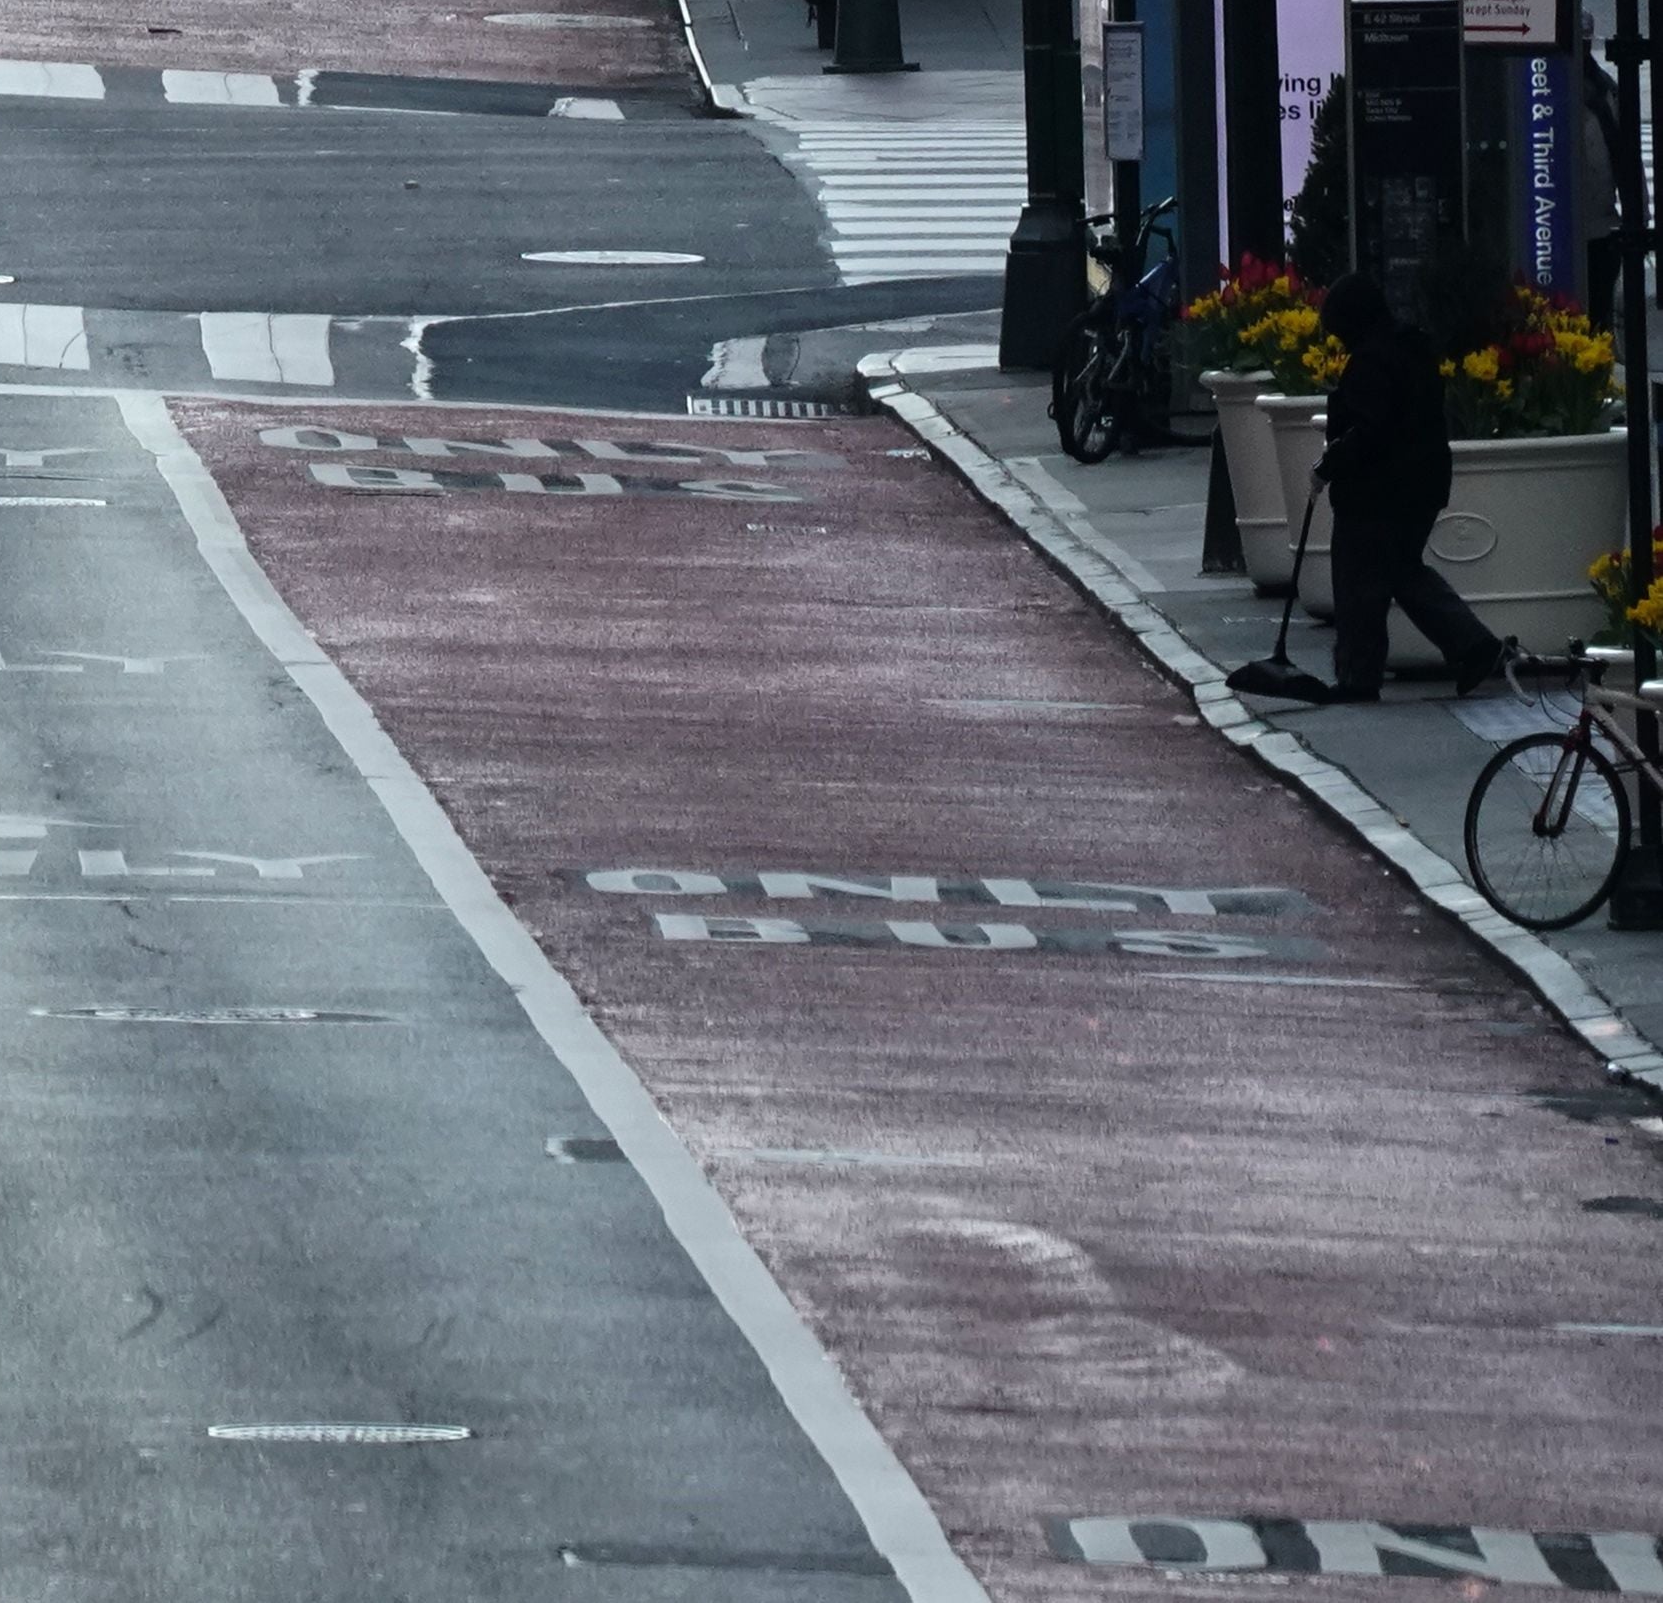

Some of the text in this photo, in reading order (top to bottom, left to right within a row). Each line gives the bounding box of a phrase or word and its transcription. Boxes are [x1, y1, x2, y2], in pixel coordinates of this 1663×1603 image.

[1464, 3, 1530, 17] xcept Sunday
[1532, 103, 1554, 121] &
[1533, 127, 1555, 189] Third
[1534, 196, 1556, 286] Avenue
[260, 427, 821, 466] ONLY
[310, 463, 805, 503] BUS
[586, 869, 1292, 916] ONLY
[654, 913, 1271, 960] BUS
